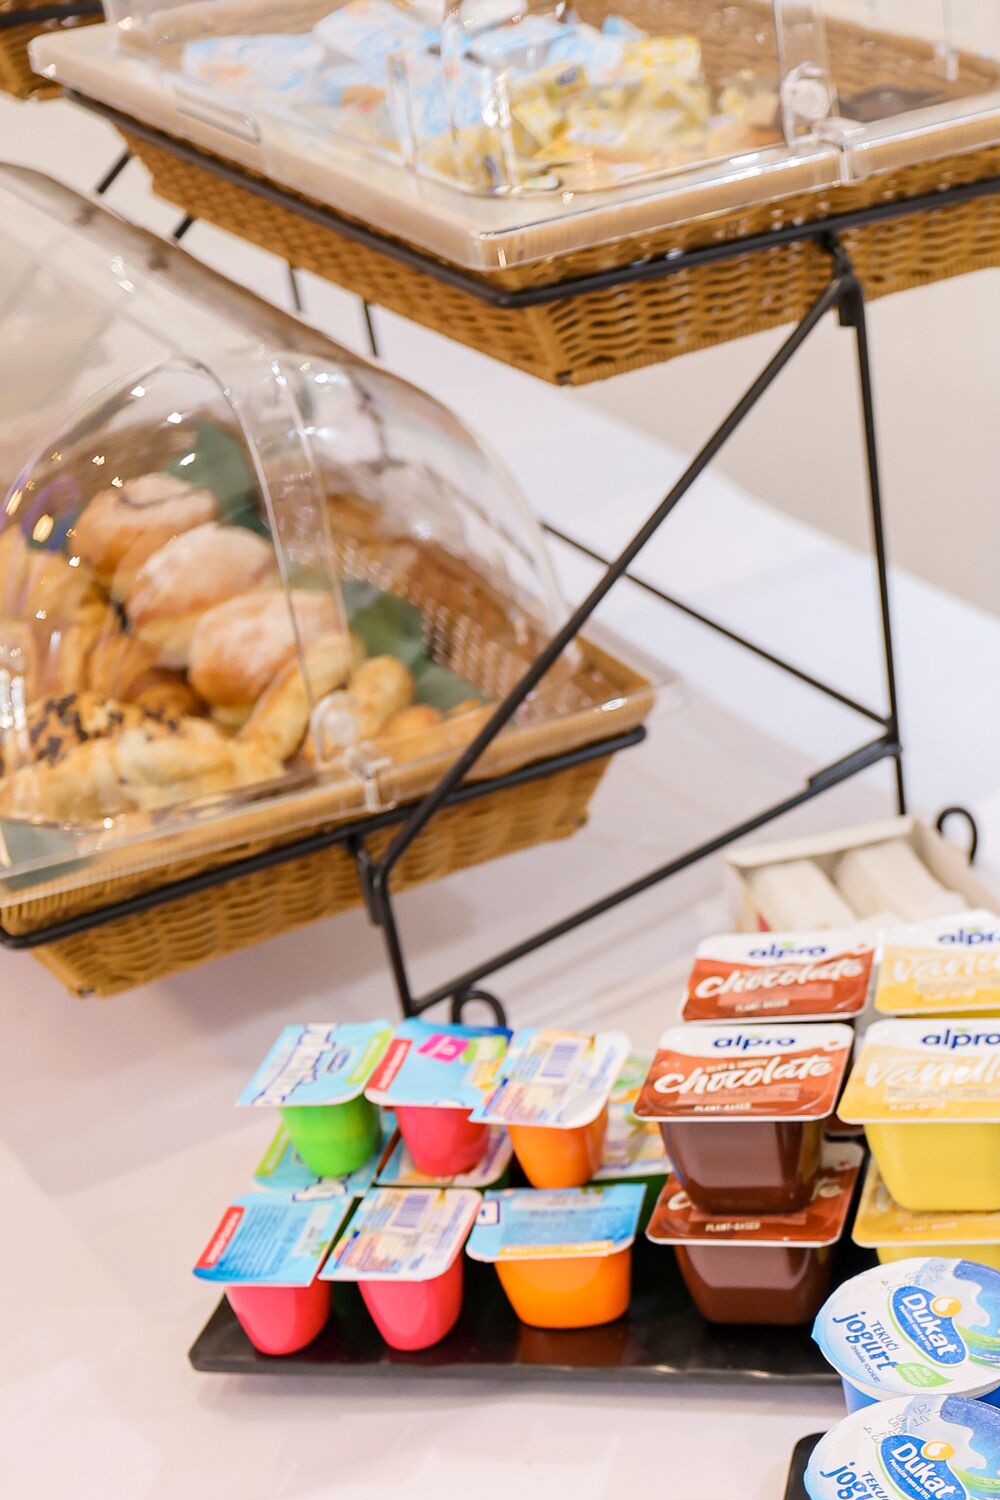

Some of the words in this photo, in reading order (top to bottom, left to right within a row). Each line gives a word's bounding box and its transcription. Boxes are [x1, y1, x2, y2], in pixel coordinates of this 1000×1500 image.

[694, 958, 864, 999] chocolate
[713, 1034, 796, 1050] alpro
[654, 1055, 833, 1095] chocolate
[832, 1311, 898, 1371] jogurt
[870, 1320, 899, 1352] TEKUĆI
[901, 1292, 958, 1356] Dukat
[891, 1442, 956, 1499] Dukat
